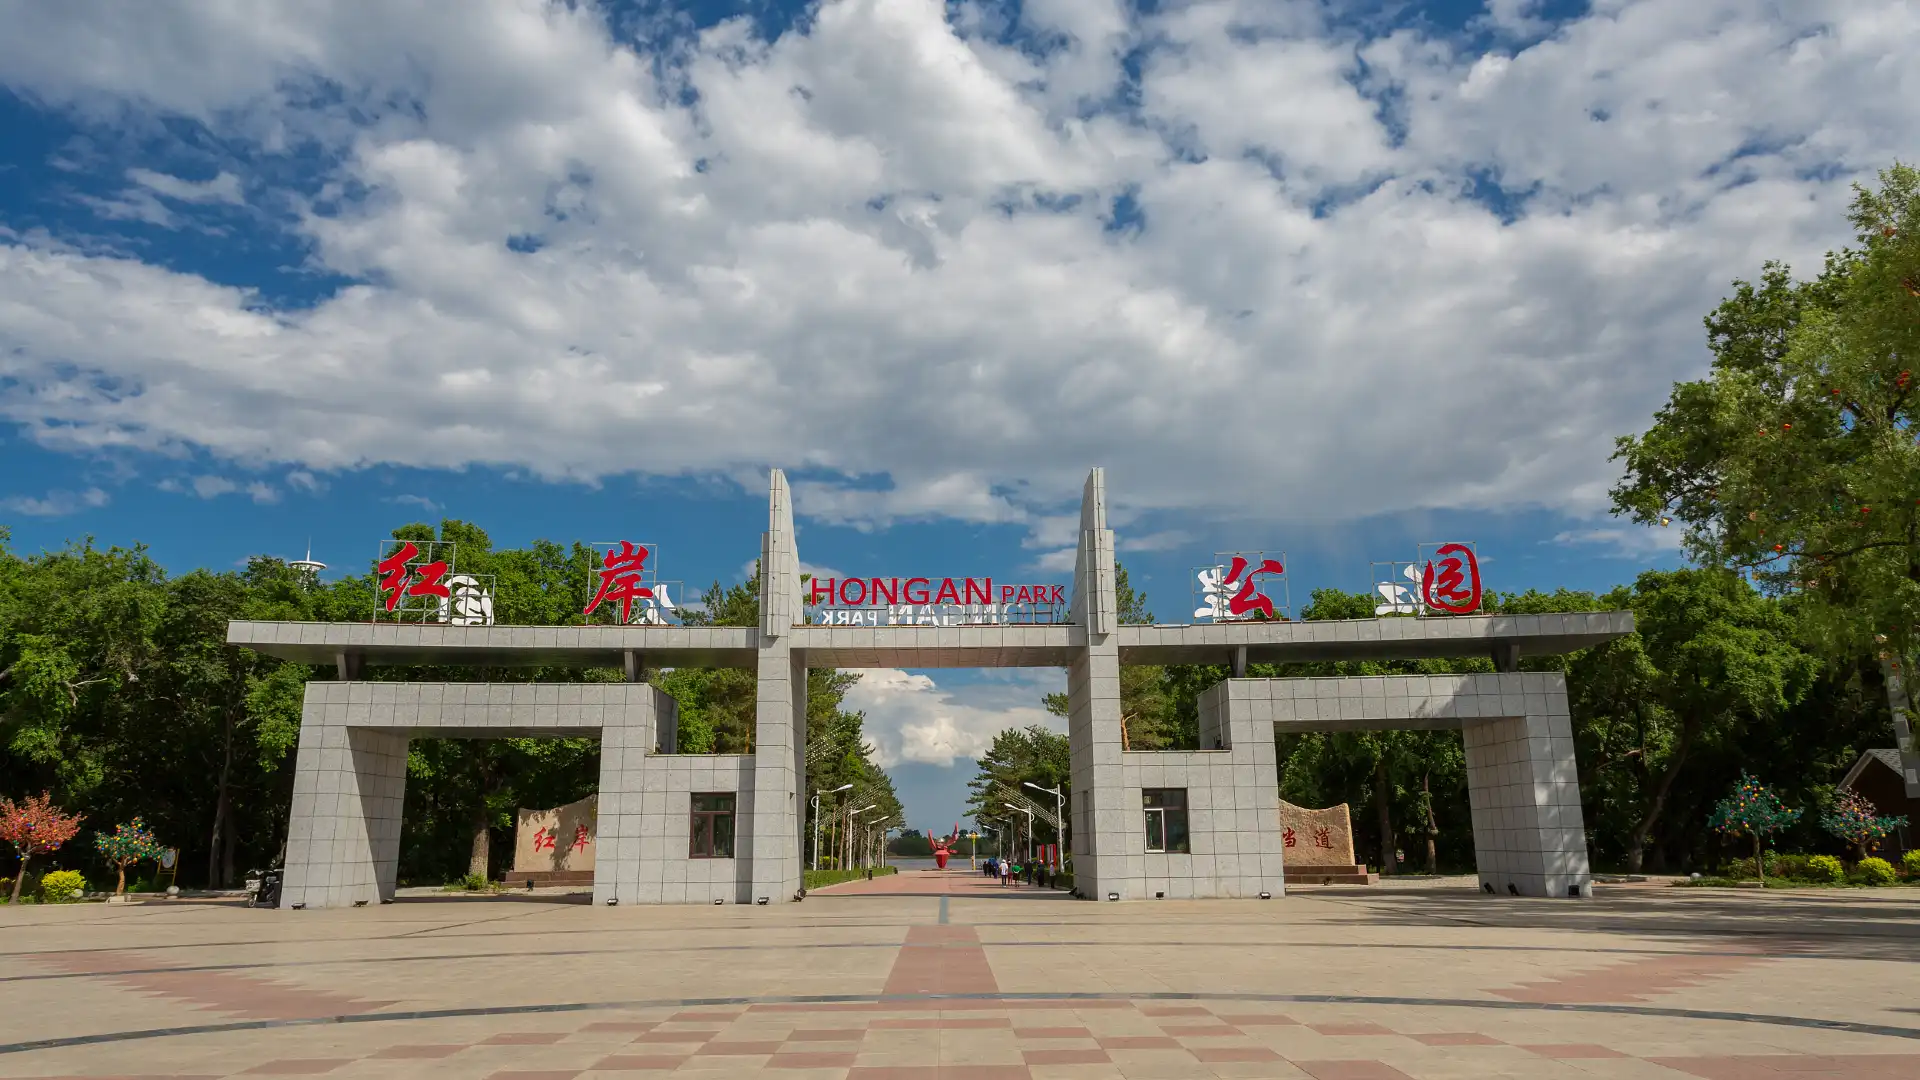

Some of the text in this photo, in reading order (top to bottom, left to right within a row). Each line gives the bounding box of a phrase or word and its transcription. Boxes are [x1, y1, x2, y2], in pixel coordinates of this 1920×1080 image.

[810, 577, 1065, 605] HONGAN PARK
[533, 824, 590, 856] 红岸
